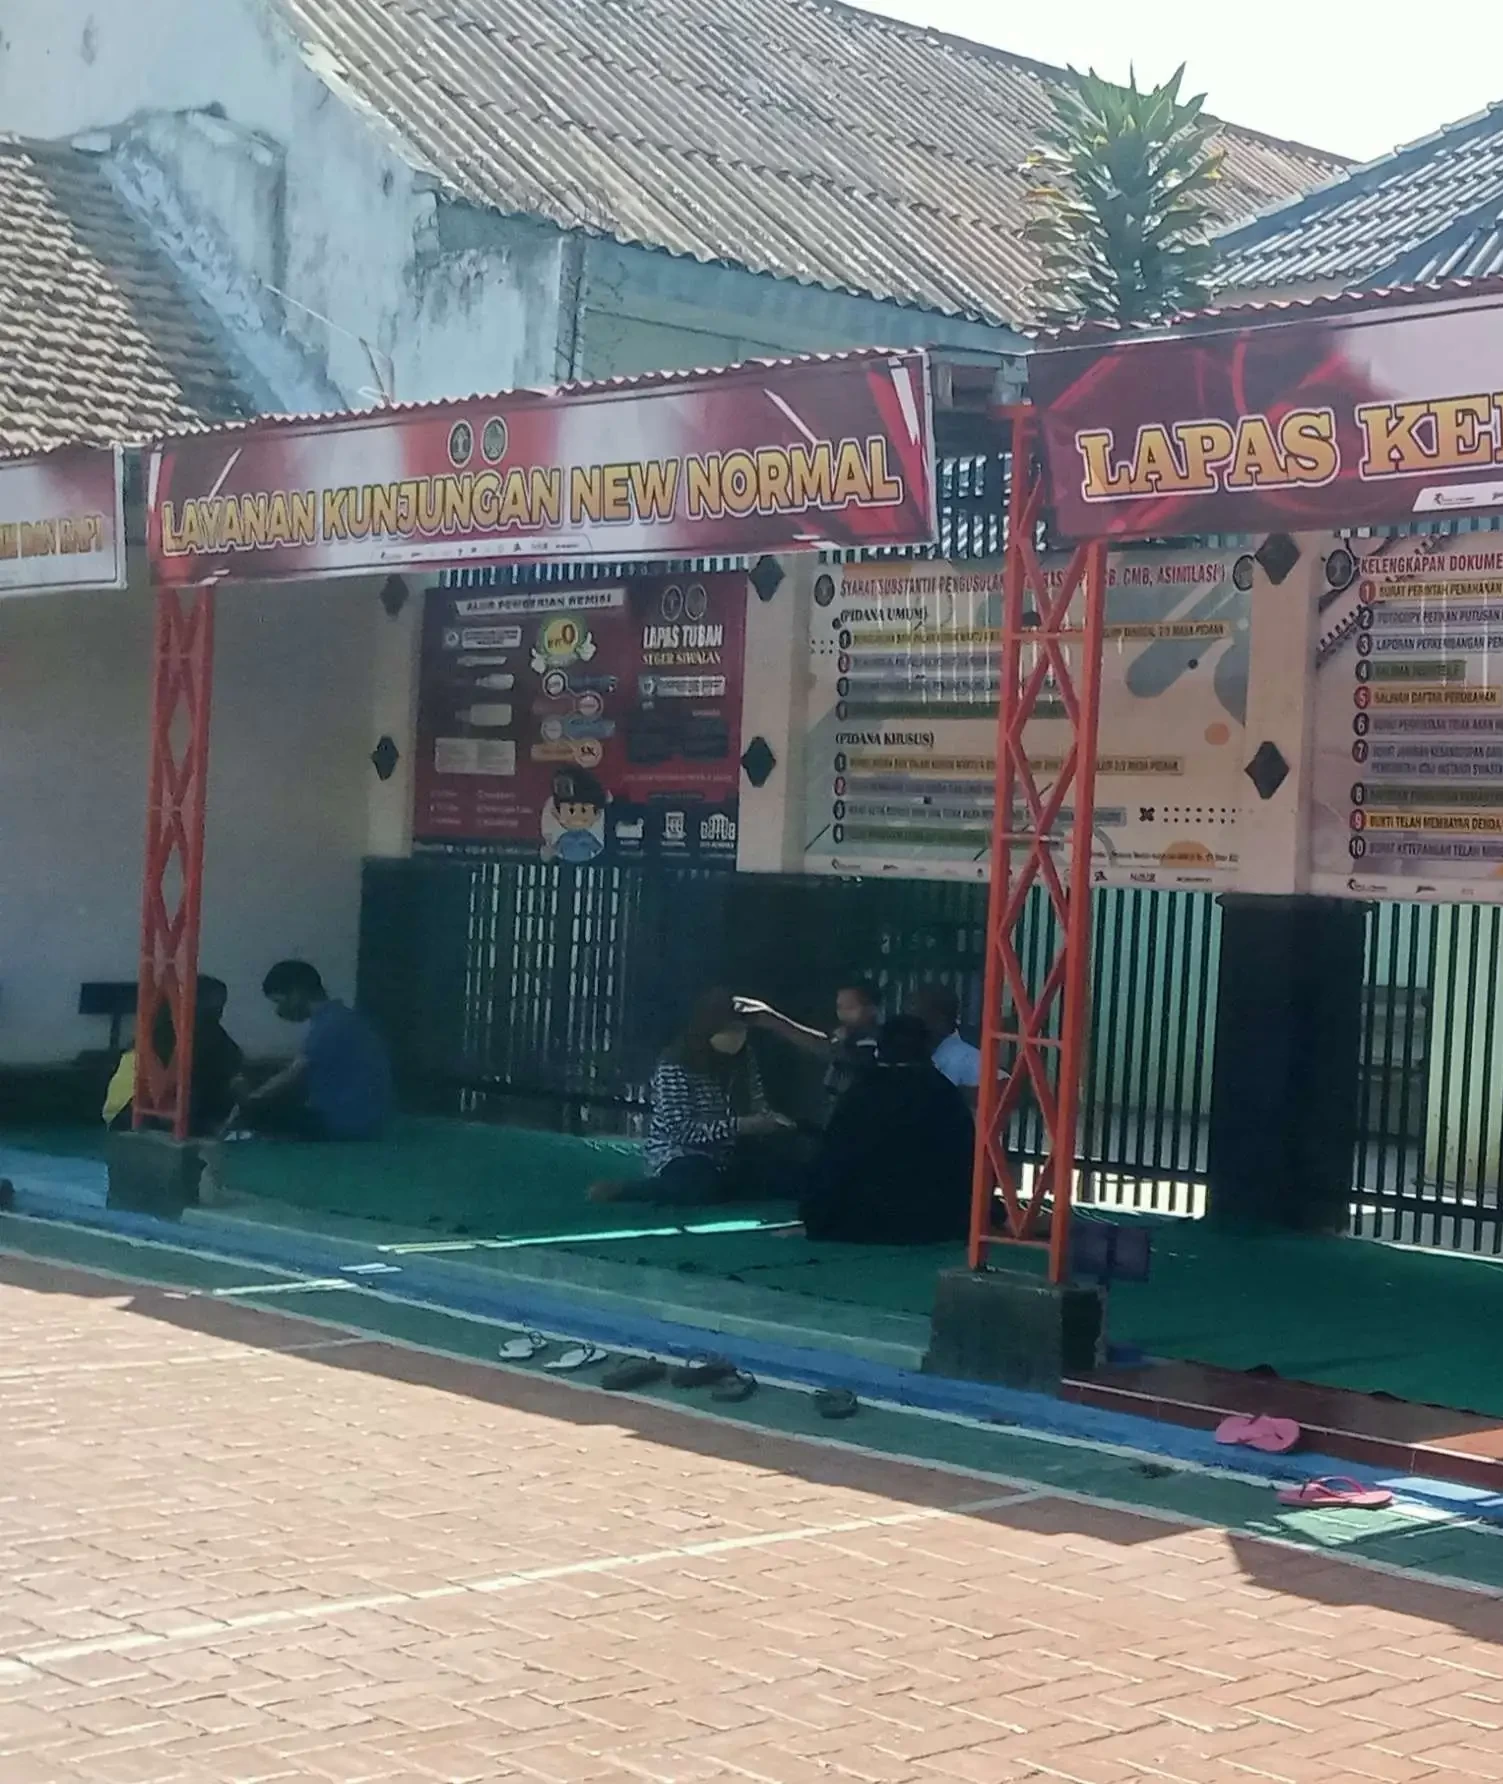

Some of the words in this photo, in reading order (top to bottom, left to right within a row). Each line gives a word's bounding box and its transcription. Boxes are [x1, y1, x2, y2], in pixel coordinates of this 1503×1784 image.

[1078, 409, 1341, 500] LAPAS
[163, 489, 317, 557] LAYANAN
[322, 468, 561, 543] KUNJUNGAN
[571, 459, 678, 523] NEW
[688, 436, 901, 520] NORMAL
[1361, 555, 1445, 575] KELENGKAPAN
[642, 624, 680, 649] LAPAS
[682, 622, 724, 648] TUBAN
[835, 731, 881, 745] (PIDANA
[883, 730, 935, 748] KHUSUS)
